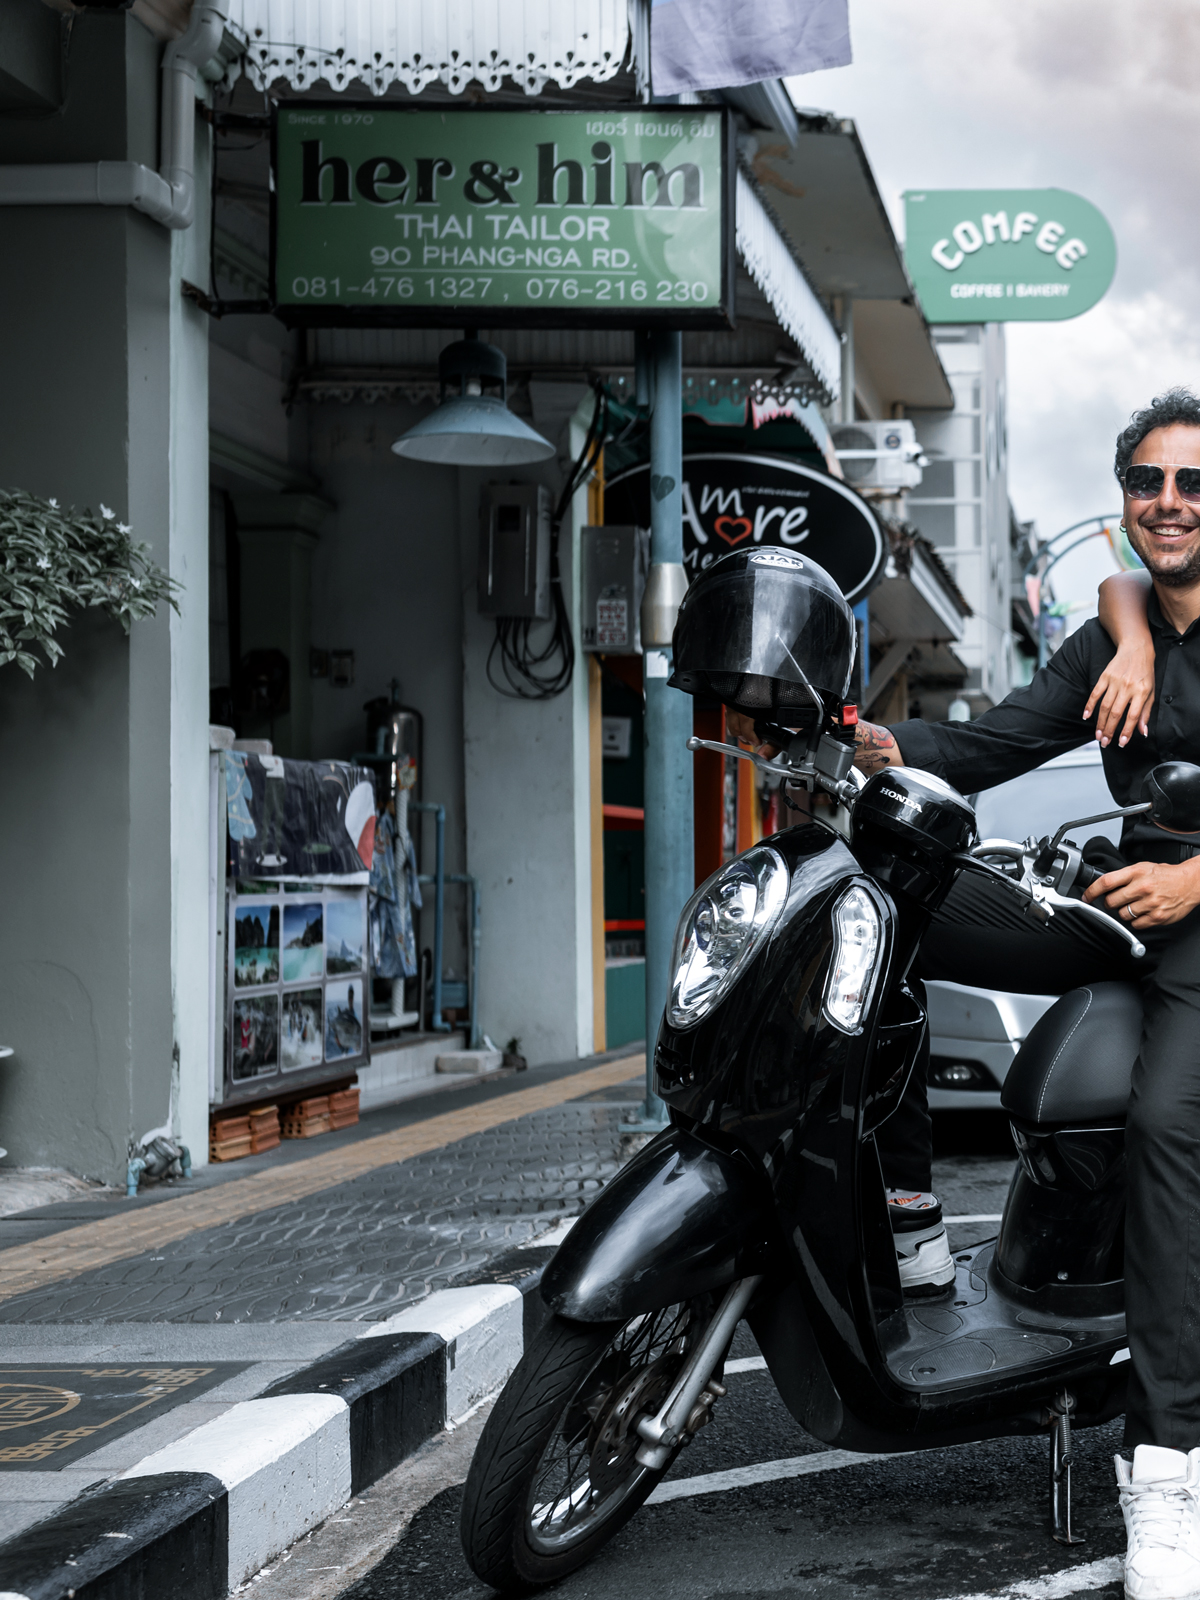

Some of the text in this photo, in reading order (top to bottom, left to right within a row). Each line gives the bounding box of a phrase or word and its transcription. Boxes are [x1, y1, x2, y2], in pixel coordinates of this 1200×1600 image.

[334, 113, 374, 126] 1970
[300, 139, 454, 207] her
[534, 141, 707, 211] him
[395, 213, 610, 243] THAI TAILOR
[931, 210, 1088, 271] COMFEE
[370, 246, 411, 266] 90
[422, 246, 582, 269] PHANG-NGA
[292, 277, 414, 299] 081-476
[424, 278, 492, 299] 1327
[526, 278, 648, 301] 076-216
[656, 280, 708, 302] 230
[950, 283, 1003, 299] COFFEE
[1015, 283, 1070, 298] BAKERY
[879, 786, 923, 813] HONDA
